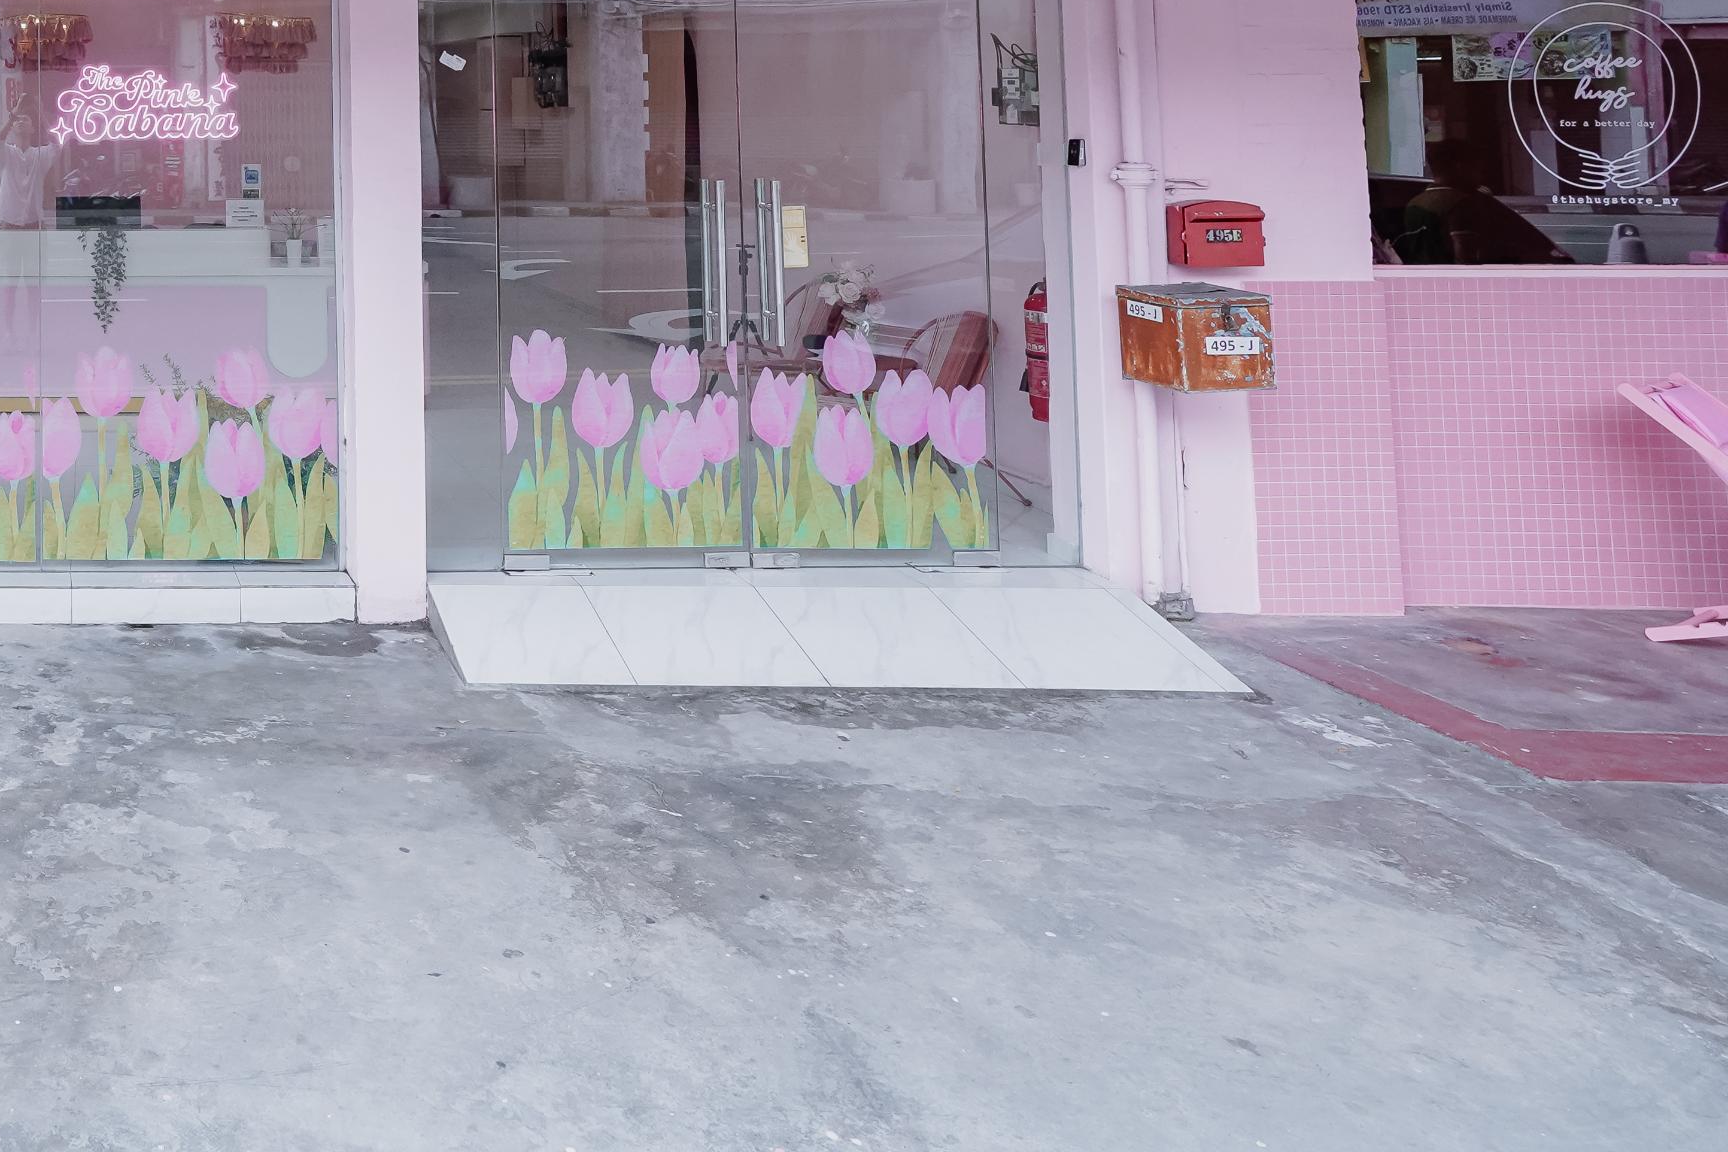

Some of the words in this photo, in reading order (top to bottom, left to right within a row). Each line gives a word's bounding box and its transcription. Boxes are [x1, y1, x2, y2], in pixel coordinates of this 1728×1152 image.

[1563, 54, 1642, 79] coffee
[78, 65, 124, 92] The
[113, 69, 203, 111] Pink
[1574, 75, 1635, 112] hugs
[58, 90, 239, 142] Cabana
[1559, 119, 1577, 127] for
[1594, 119, 1631, 127] better
[1637, 119, 1656, 129] day
[1551, 194, 1679, 207] @thehugstore_my
[1206, 229, 1243, 242] 495E
